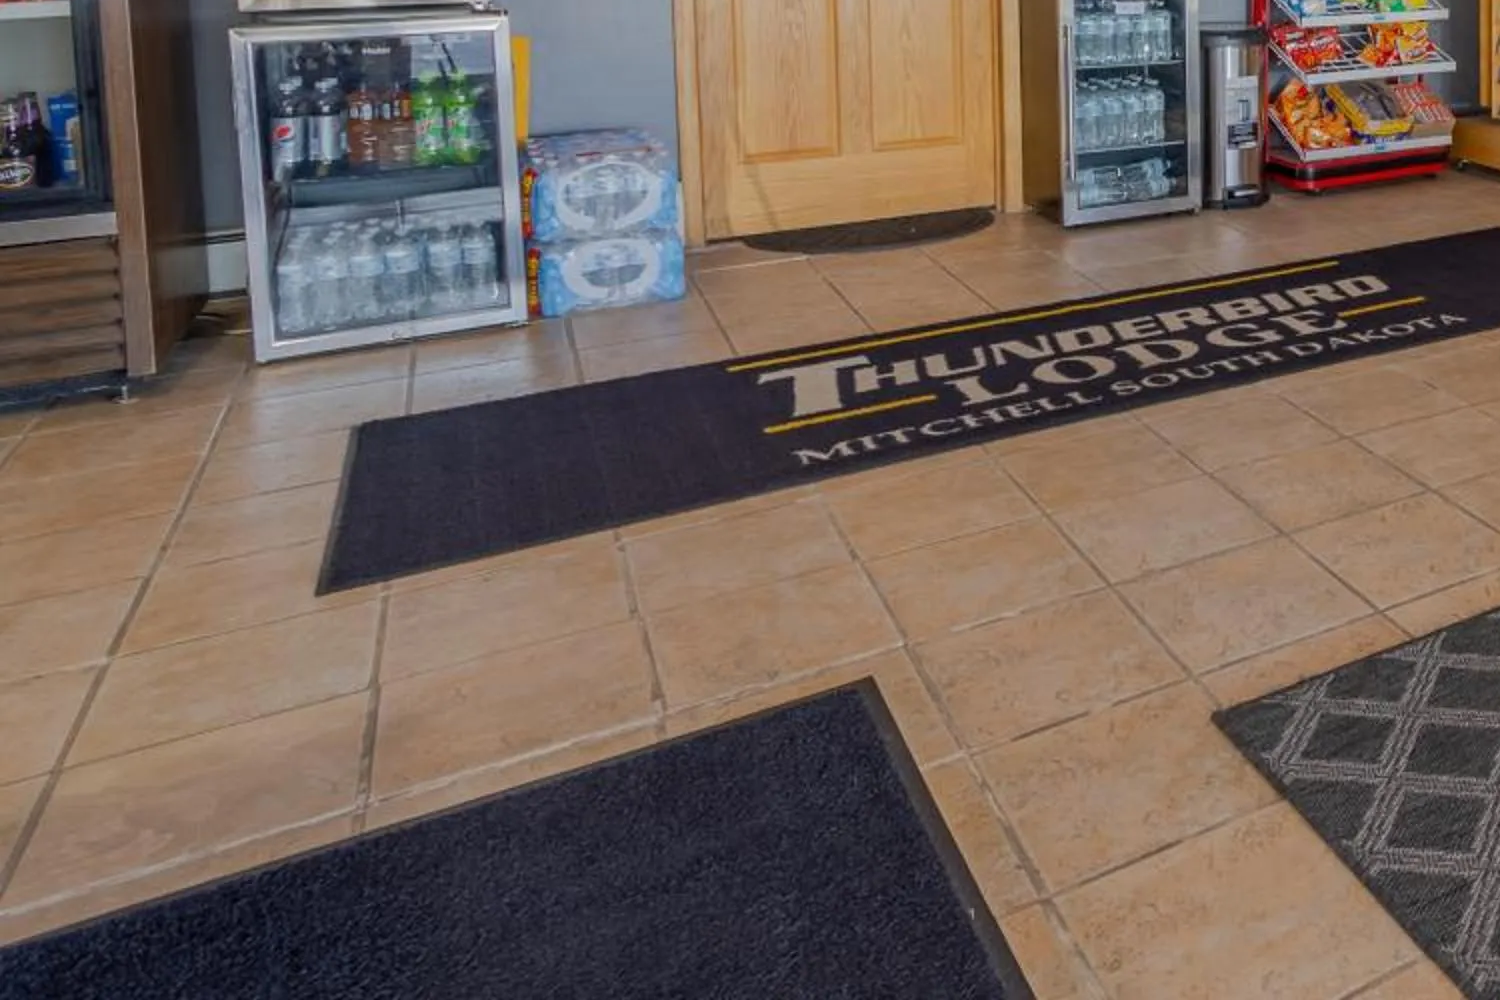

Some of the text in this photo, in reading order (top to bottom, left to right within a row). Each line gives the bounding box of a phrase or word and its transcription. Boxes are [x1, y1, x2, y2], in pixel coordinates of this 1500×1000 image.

[756, 275, 1390, 418] THUNDERBIRD
[791, 311, 1469, 465] MITCHELL SOUTH DAKOTA
[944, 309, 1348, 406] LODGE
